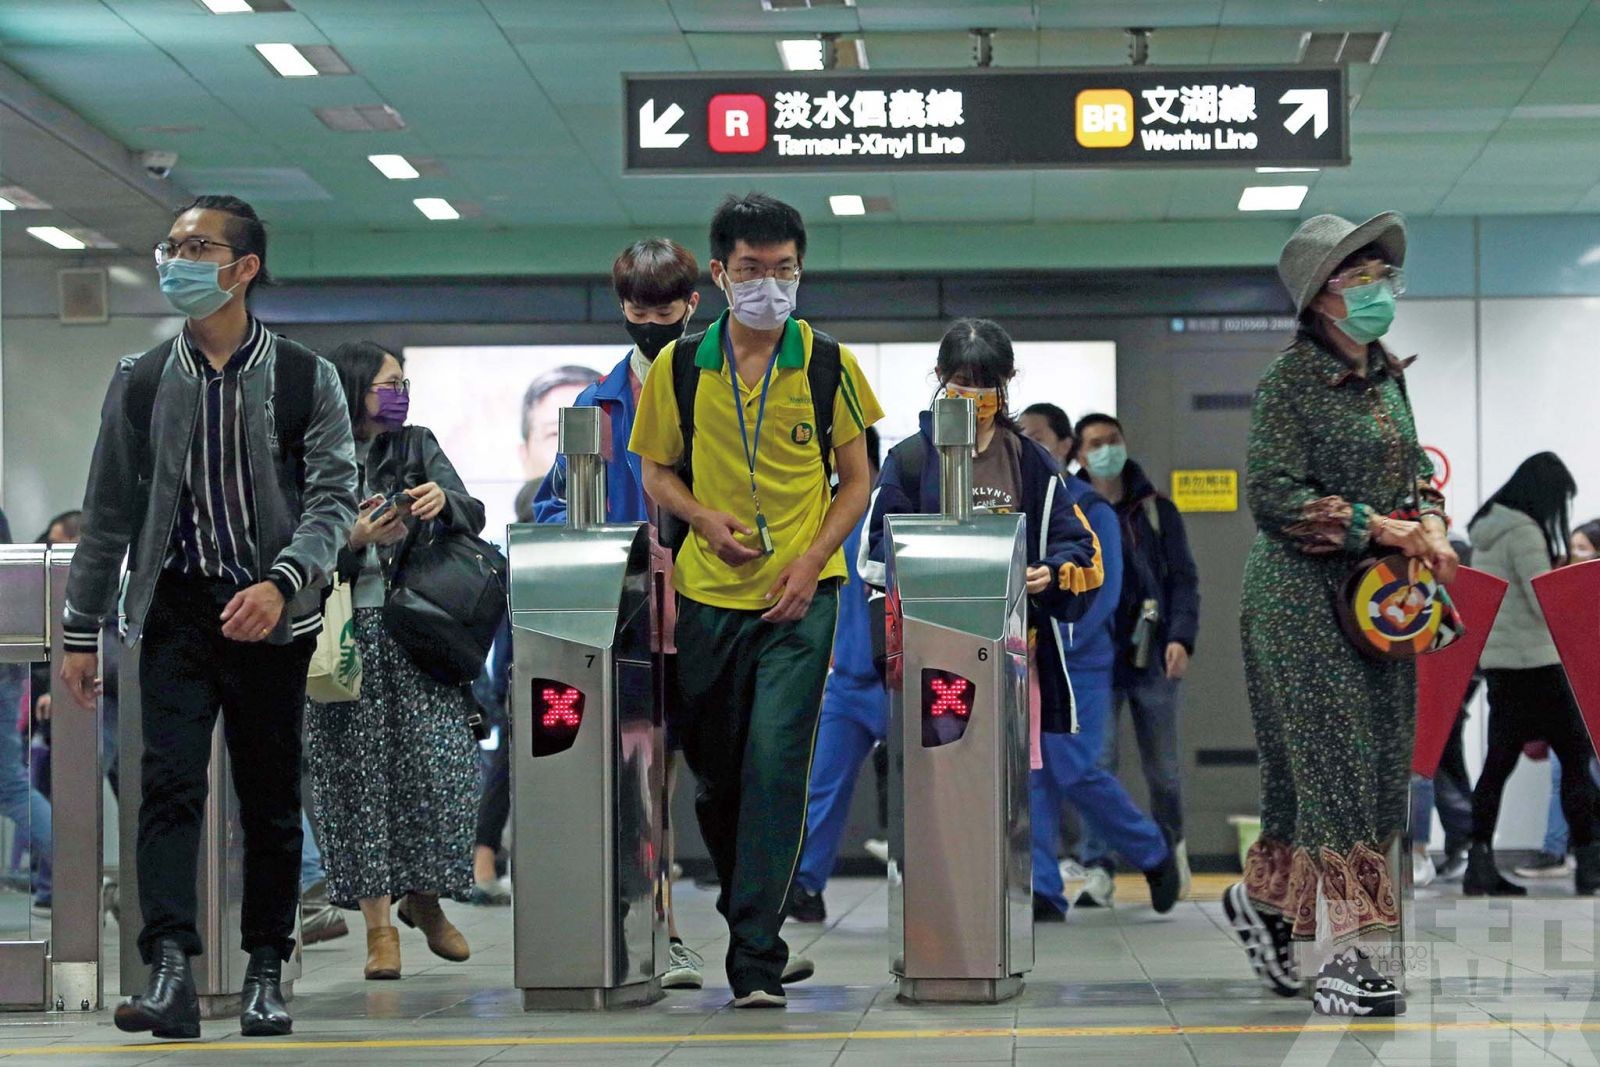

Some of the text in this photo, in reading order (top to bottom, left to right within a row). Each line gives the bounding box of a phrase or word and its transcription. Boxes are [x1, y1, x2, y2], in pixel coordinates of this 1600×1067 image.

[773, 89, 965, 129] 淡水信義線
[1140, 85, 1258, 124] 文湖線
[725, 110, 749, 137] R
[1082, 104, 1127, 132] BR
[918, 133, 965, 154] Line
[1140, 128, 1258, 151] Wenhu Line
[972, 487, 1012, 503] KLYN'S
[584, 654, 596, 669] 7
[977, 647, 988, 662] 6
